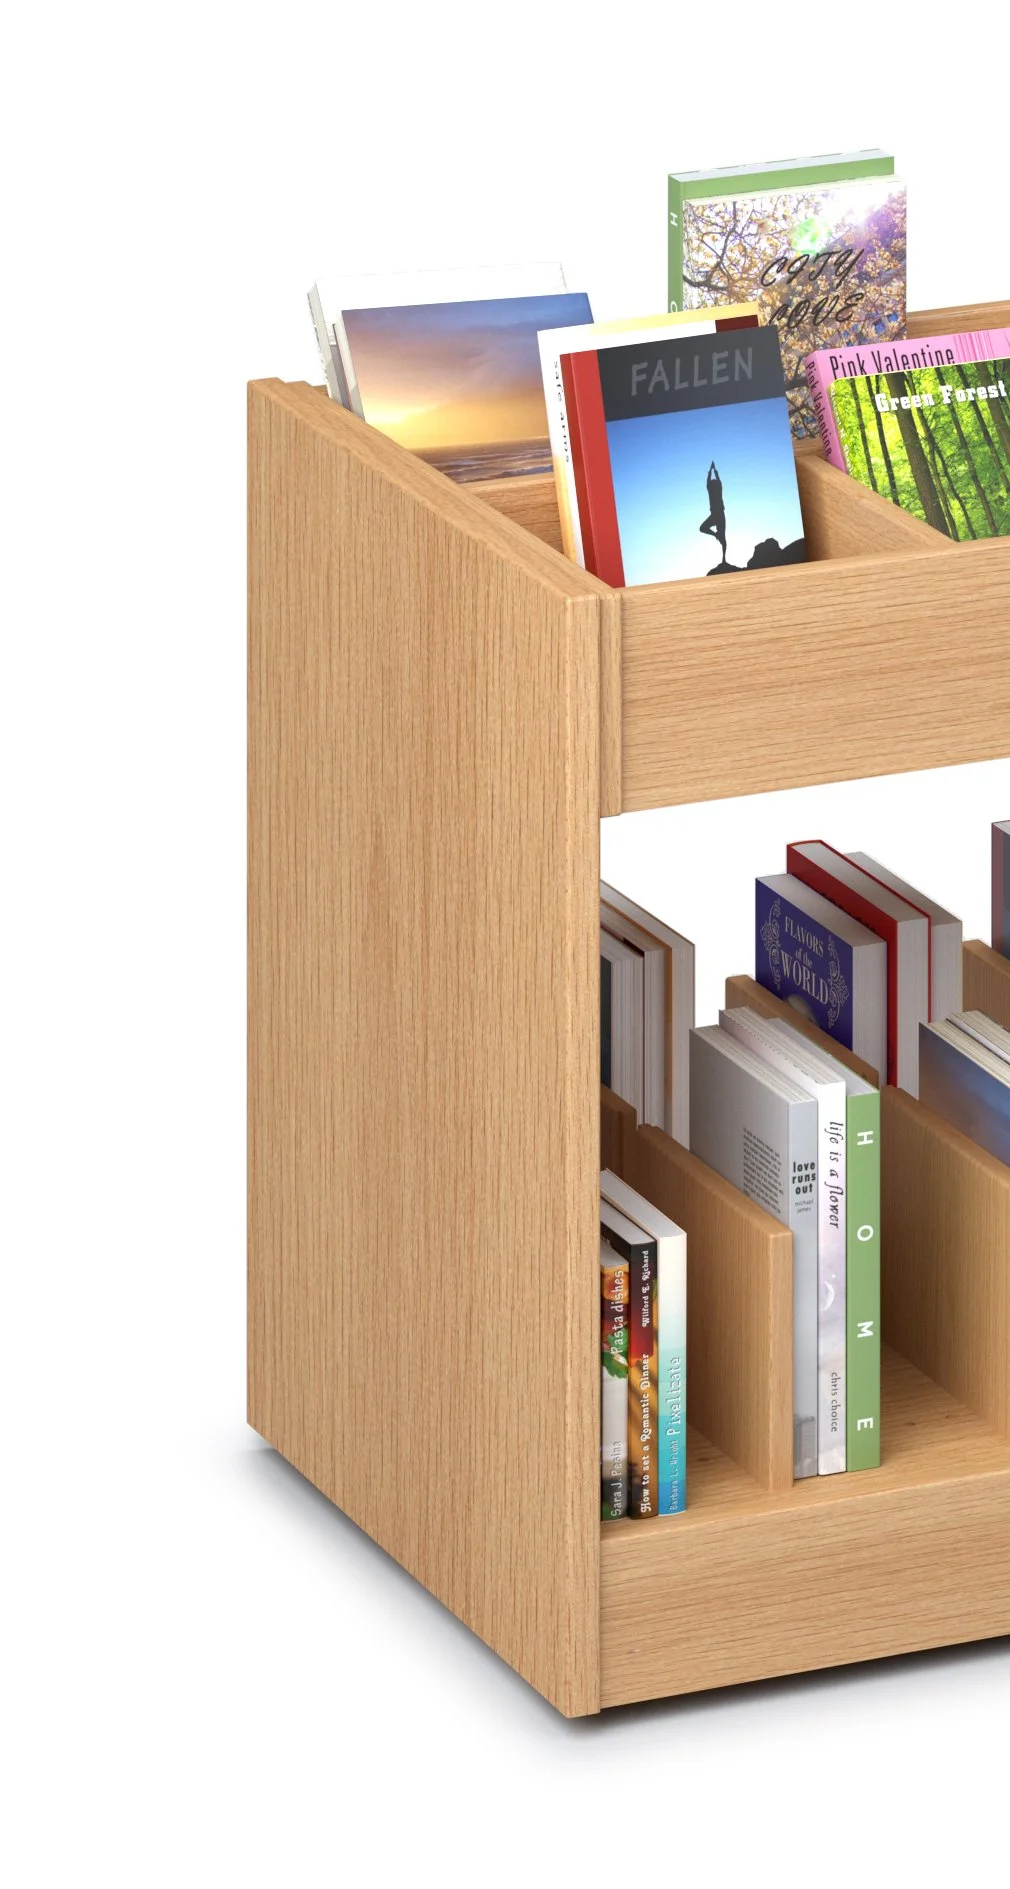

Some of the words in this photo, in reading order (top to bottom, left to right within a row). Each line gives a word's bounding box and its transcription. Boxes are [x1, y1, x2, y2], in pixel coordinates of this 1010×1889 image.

[761, 248, 865, 290] CITY
[630, 347, 753, 397] FALLEN
[829, 352, 868, 380] Pink
[871, 344, 956, 374] Valentine
[805, 361, 821, 397] Pink
[813, 391, 833, 457] Valentine
[874, 392, 935, 413] Green
[939, 380, 1008, 405] Forest
[784, 915, 824, 958] FLAVORS
[802, 951, 813, 969] the
[780, 949, 829, 1005] WORLD
[824, 1121, 844, 1144] life
[792, 1161, 816, 1173] love
[829, 1151, 841, 1162] is
[792, 1173, 816, 1184] runs
[795, 1183, 813, 1195] out
[829, 1169, 839, 1178] a
[824, 1181, 844, 1229] flower
[641, 1250, 651, 1281] Richard
[610, 1270, 624, 1313] dishes
[610, 1316, 624, 1355] Pasta
[640, 1353, 651, 1390] Dinner
[831, 1371, 841, 1397] chris
[640, 1393, 652, 1442] Romantic
[831, 1399, 841, 1433] choice
[641, 1455, 650, 1470] set
[610, 1478, 622, 1489] J.
[641, 1474, 650, 1486] to
[669, 1479, 678, 1510] Barbara
[610, 1492, 622, 1517] Sara
[640, 1488, 652, 1513] How
